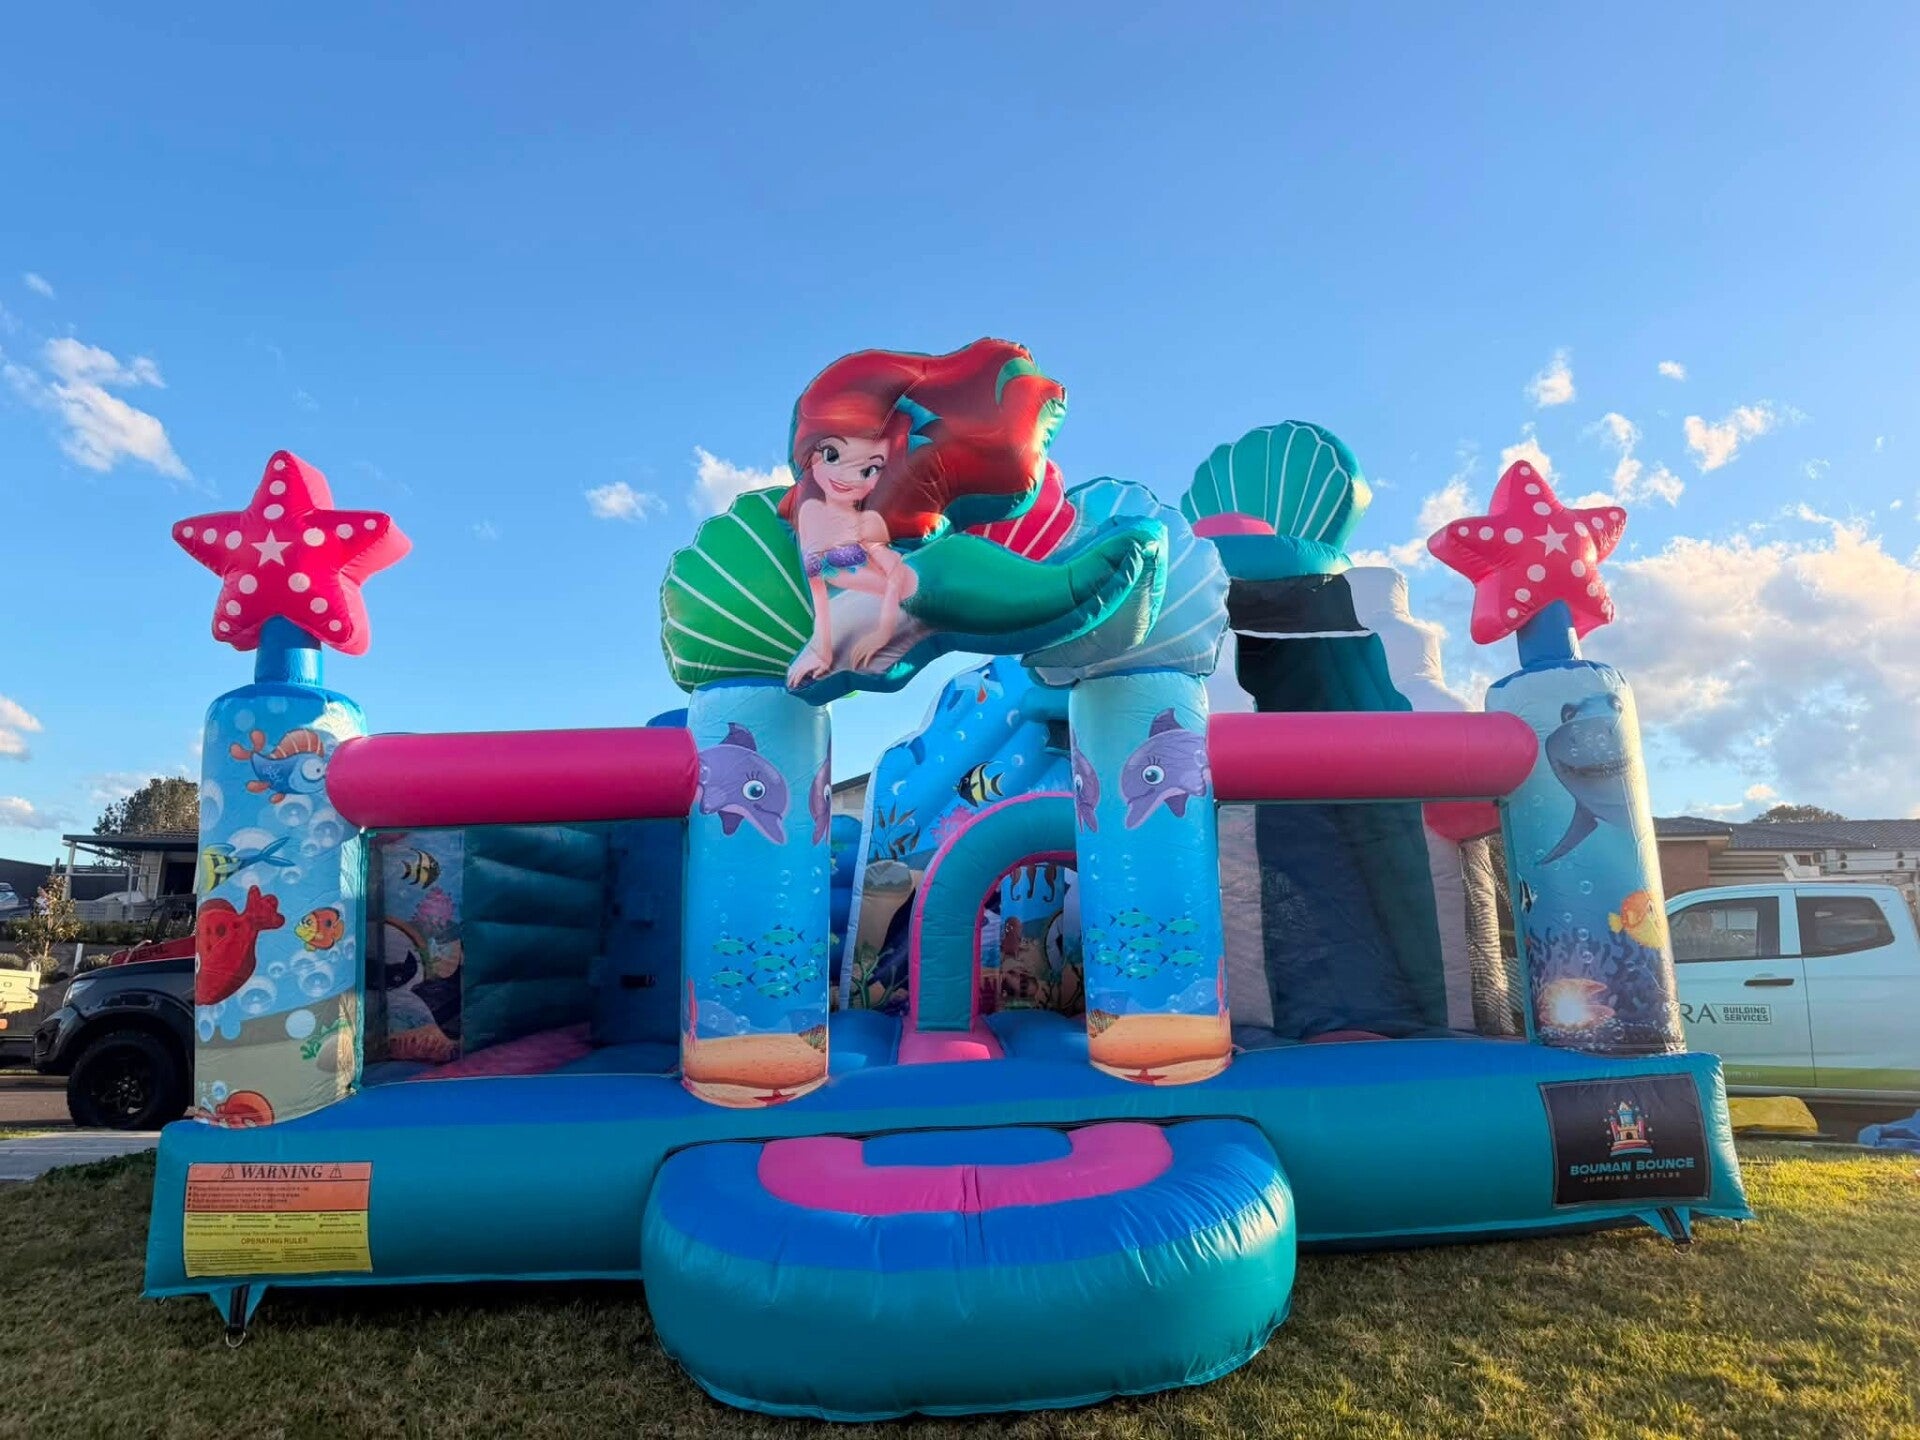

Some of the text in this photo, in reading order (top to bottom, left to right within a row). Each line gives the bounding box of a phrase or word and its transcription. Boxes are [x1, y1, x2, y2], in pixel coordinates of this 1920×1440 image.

[1723, 1006, 1766, 1014] BUILDING
[1724, 1014, 1769, 1022] SERVICES
[1569, 1157, 1695, 1176] BOUMAN BOUNCE
[240, 1165, 323, 1179] WARNING
[1583, 1171, 1681, 1183] JUMPING CASTLES
[241, 1237, 282, 1245] OPERATING
